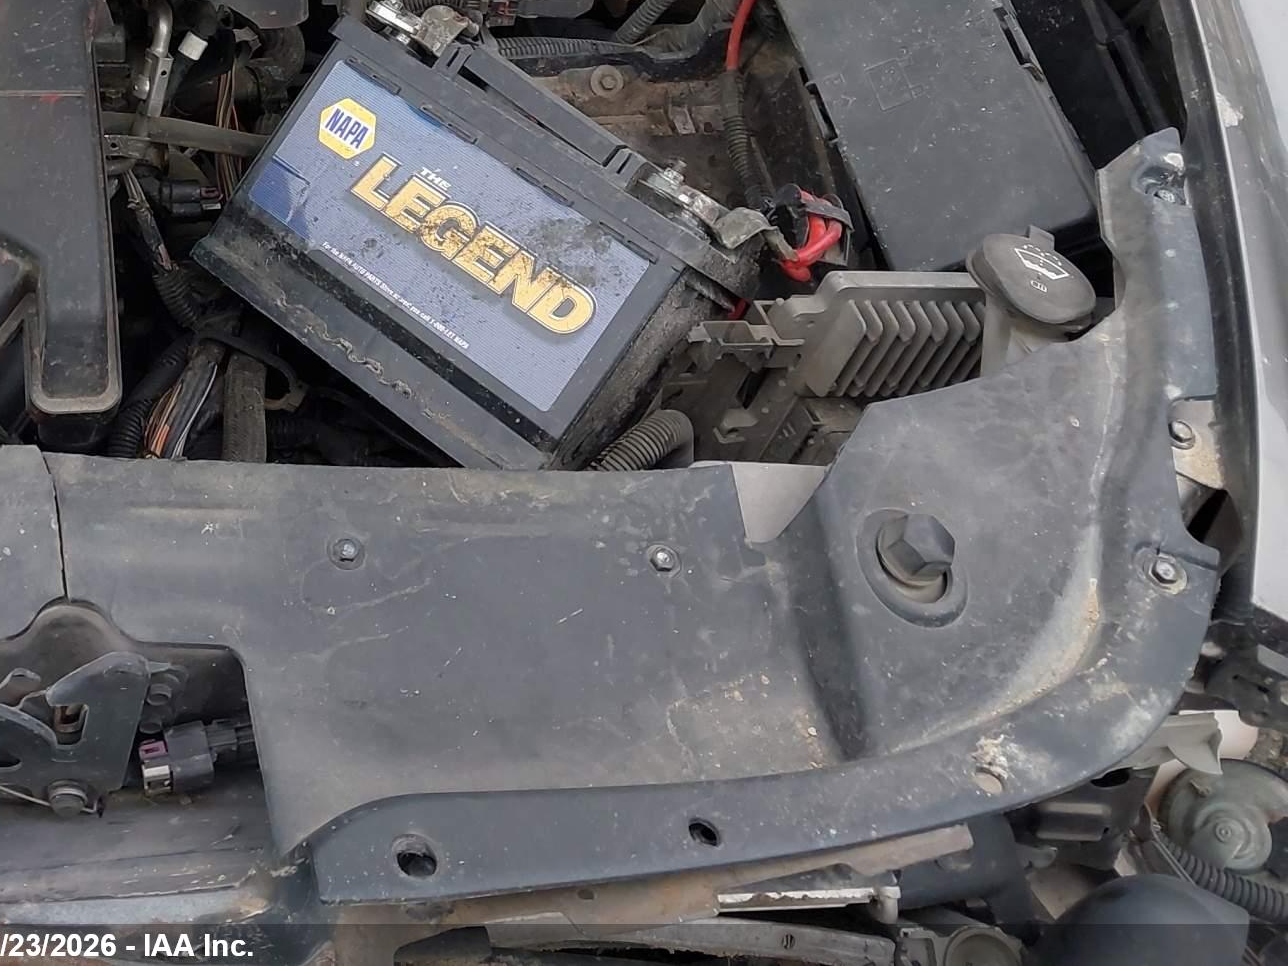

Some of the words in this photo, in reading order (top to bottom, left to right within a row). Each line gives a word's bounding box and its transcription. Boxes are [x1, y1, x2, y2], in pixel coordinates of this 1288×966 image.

[327, 106, 371, 149] NAPA
[419, 166, 452, 191] THE
[351, 153, 598, 335] LEGEND
[352, 262, 366, 275] AUTO
[365, 270, 381, 286] PARTS
